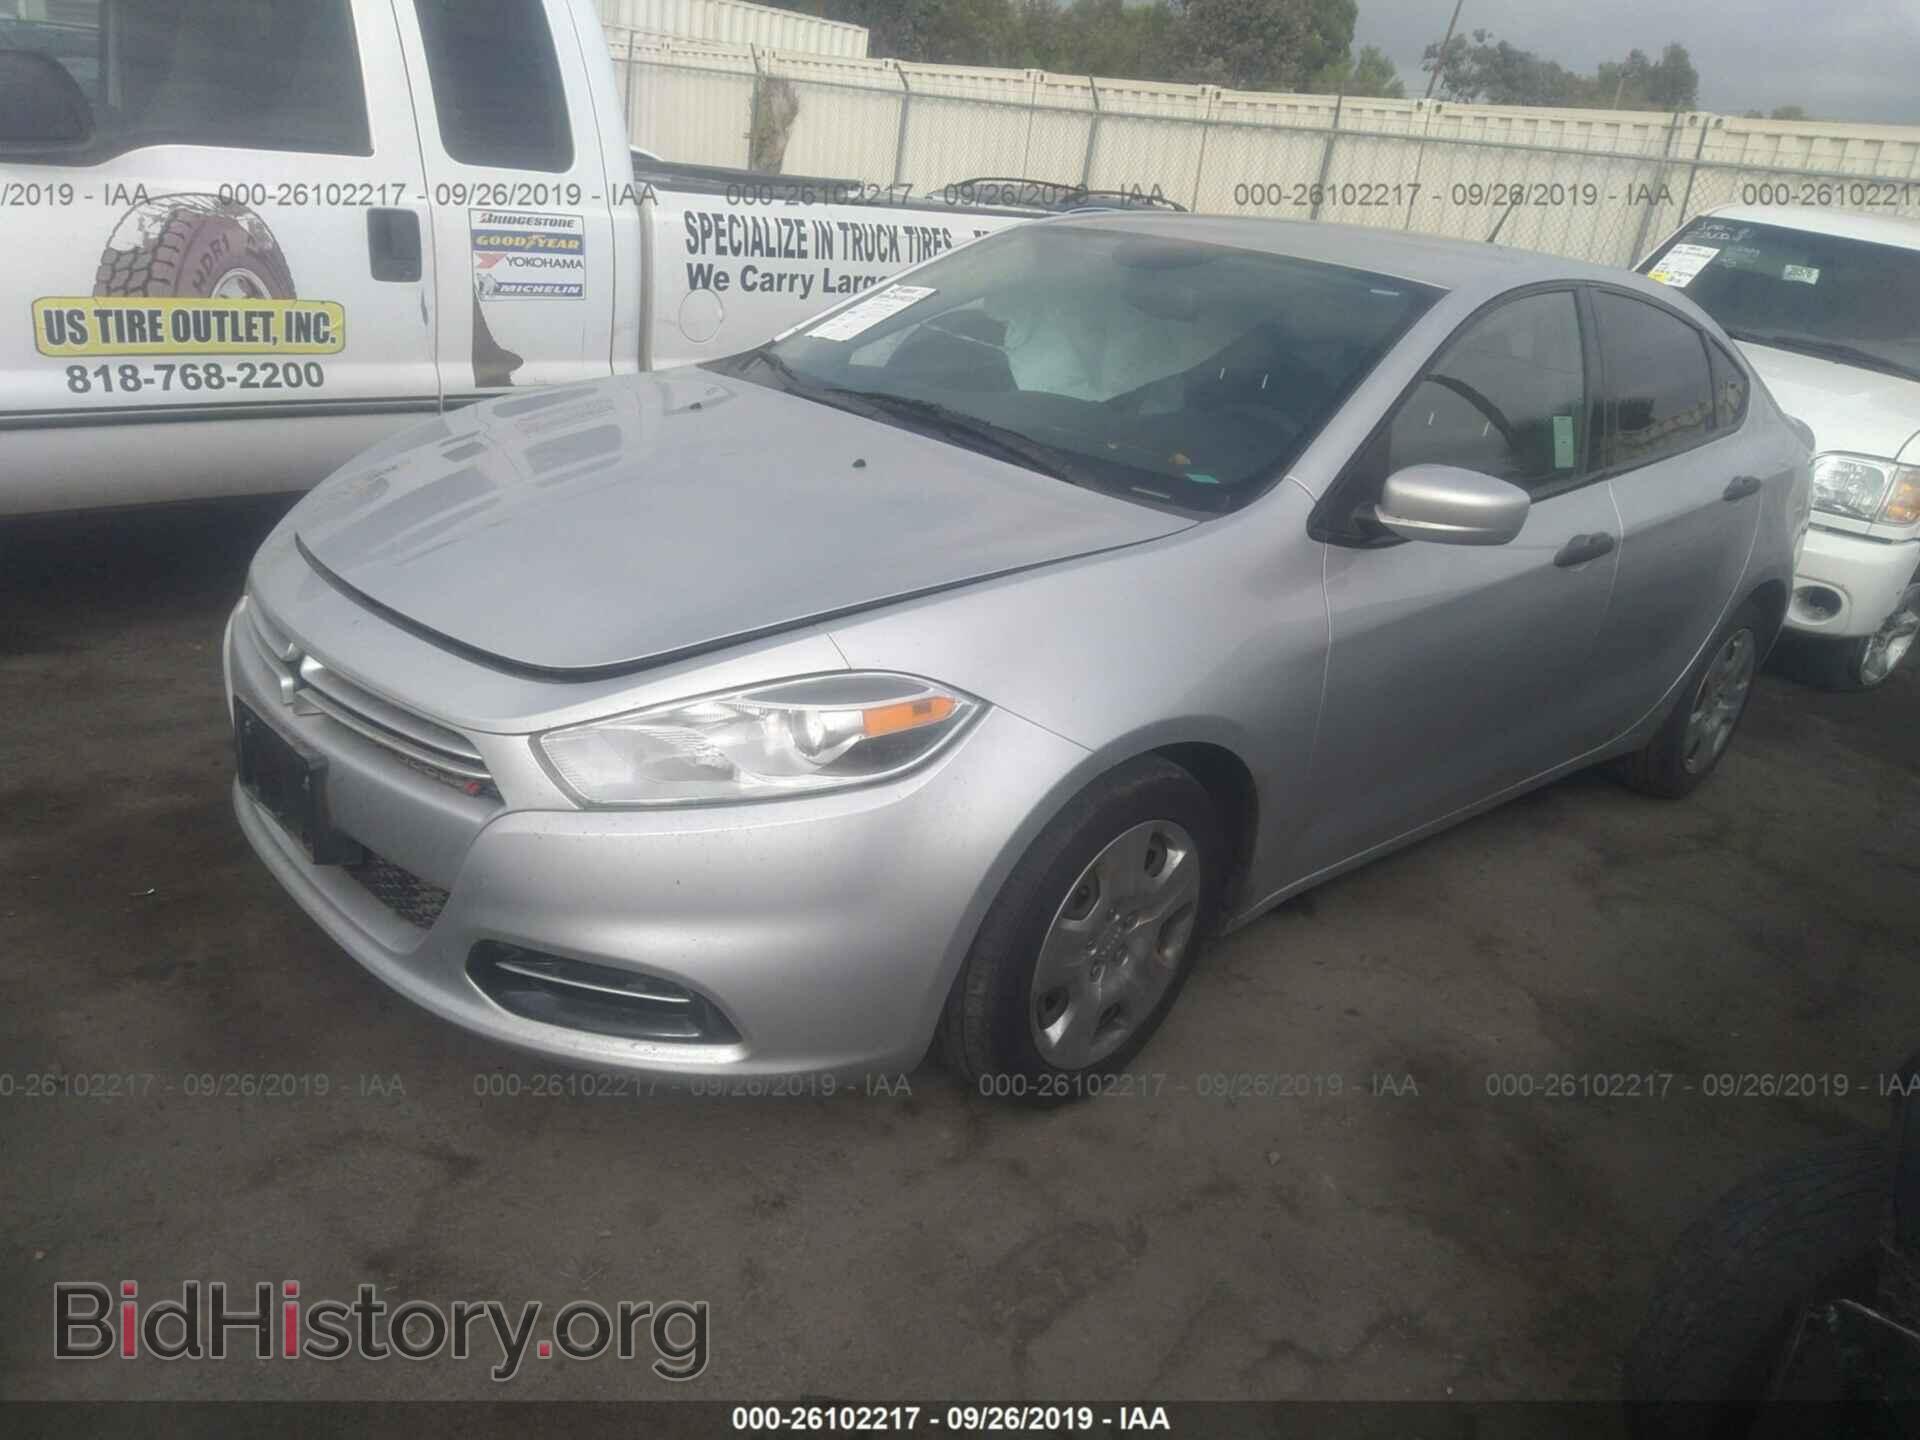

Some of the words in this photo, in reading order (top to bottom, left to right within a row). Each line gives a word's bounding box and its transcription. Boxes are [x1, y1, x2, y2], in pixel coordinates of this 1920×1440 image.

[479, 212, 576, 228] BRIDGESTONE
[476, 232, 579, 249] GOODYEAR
[684, 210, 808, 259] SPECIALIZE
[812, 219, 834, 261] IN
[838, 222, 900, 264] TRUCK
[506, 256, 584, 270] YOKOHAMA
[500, 284, 580, 294] MICHELIN
[686, 263, 730, 292] We
[739, 265, 815, 299] Carry
[43, 309, 88, 345] US
[94, 309, 165, 344] TIRE
[171, 309, 278, 345] OUTLET,
[284, 311, 336, 344] INC.
[65, 361, 324, 393] 818-768-2200
